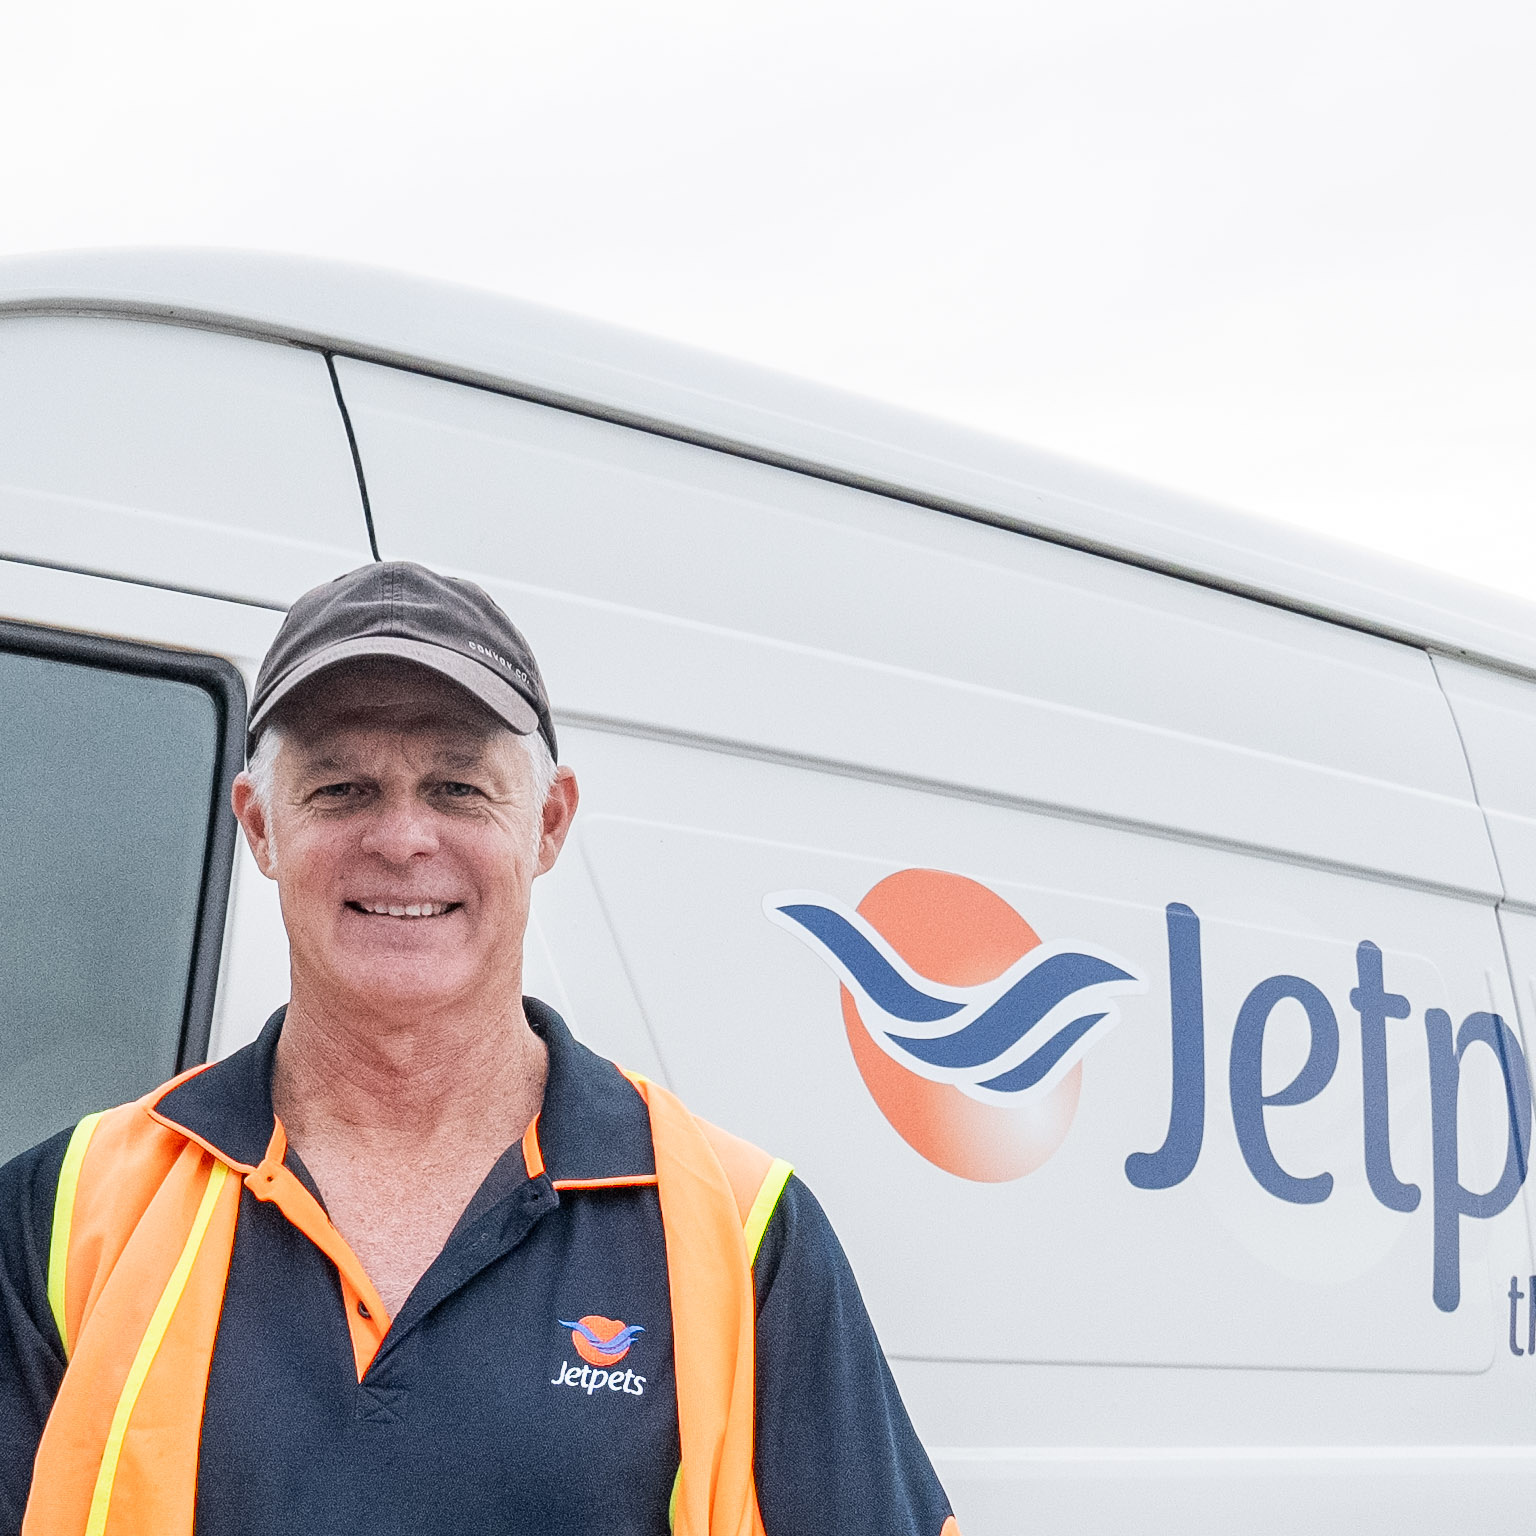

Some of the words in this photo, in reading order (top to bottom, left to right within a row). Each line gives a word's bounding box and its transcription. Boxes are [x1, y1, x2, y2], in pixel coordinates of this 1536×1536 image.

[468, 640, 513, 670] CONVOY
[515, 668, 530, 685] CO.
[551, 1360, 647, 1396] Jetpets
